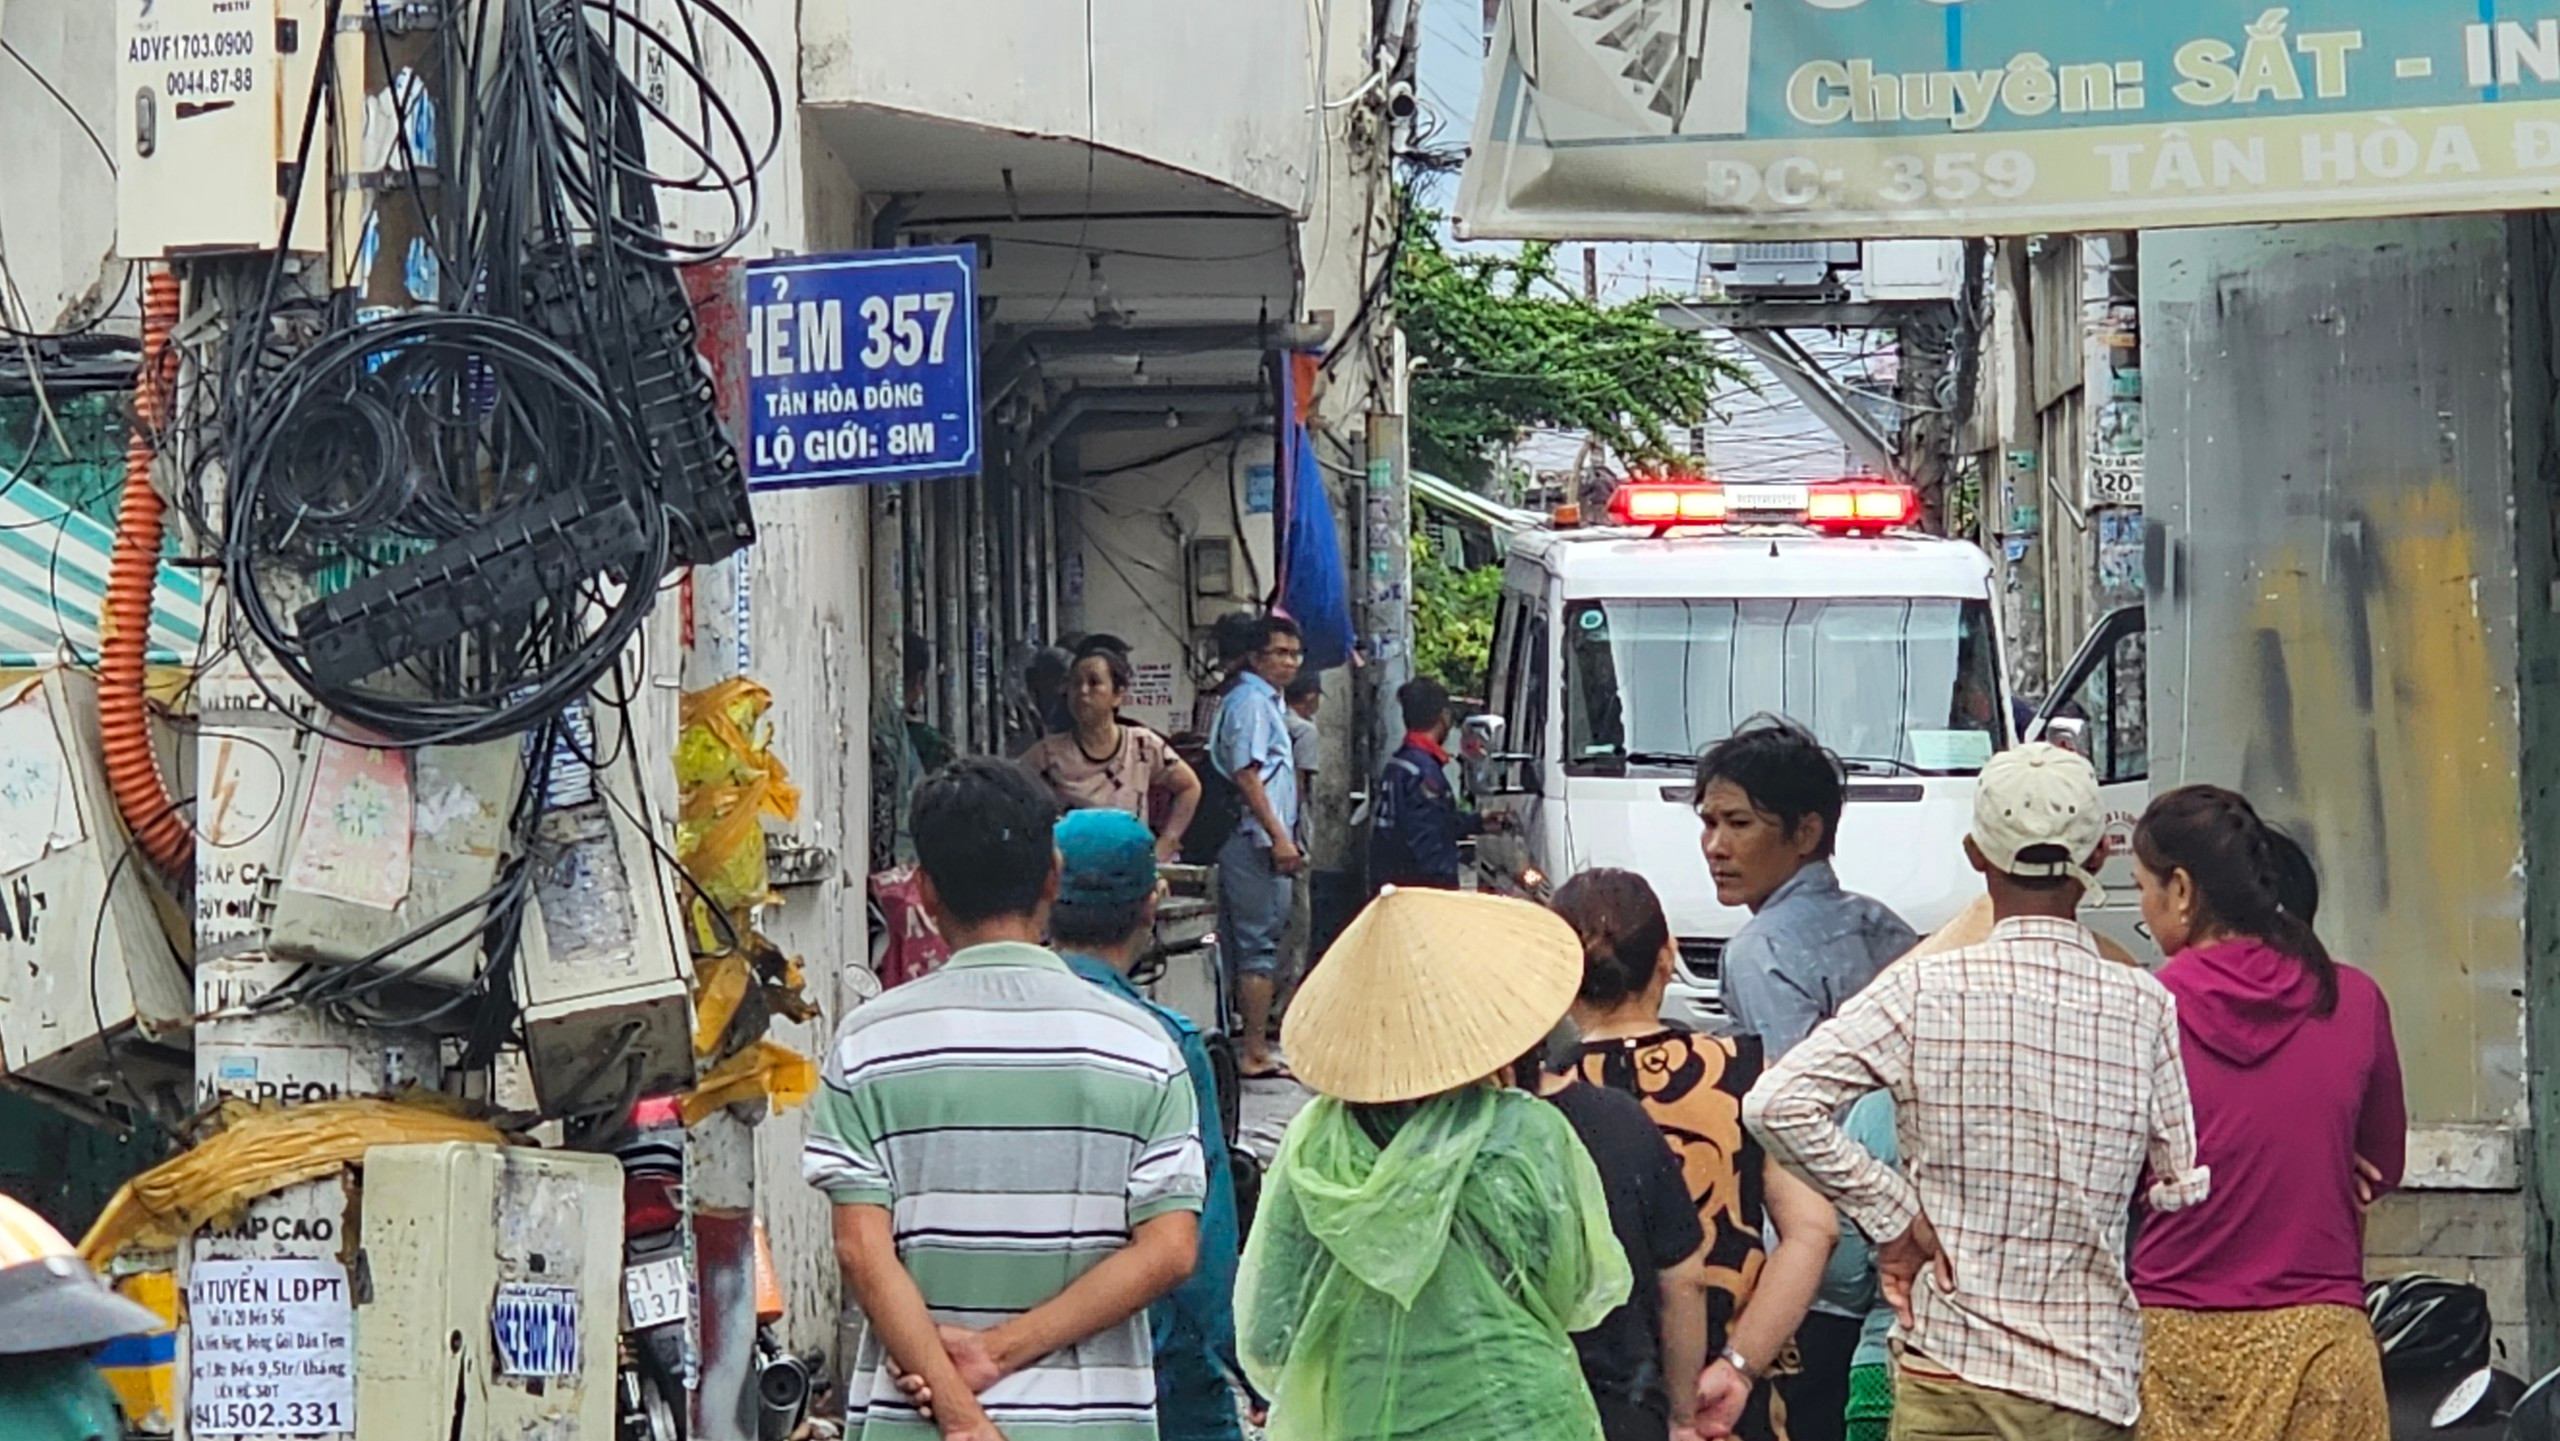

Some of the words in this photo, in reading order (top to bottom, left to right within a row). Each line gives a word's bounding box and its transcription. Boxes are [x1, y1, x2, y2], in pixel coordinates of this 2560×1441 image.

[128, 30, 253, 63] ADVF1703.0900
[1786, 52, 2144, 132] Chuyên:
[2172, 8, 2361, 105] SẮT
[2466, 19, 2560, 86] IN
[1703, 156, 1844, 206] ĐC:
[1878, 149, 2036, 203] 359
[2094, 126, 2267, 193] TÂN
[2302, 116, 2480, 183] HÒA
[859, 291, 955, 369] 357
[765, 385, 807, 418] TÂN
[813, 382, 860, 415] HÒA
[864, 379, 924, 410] ĐÔNG
[756, 425, 796, 471] LỘ
[804, 420, 878, 463] GIỚI:
[887, 422, 935, 456] 8M
[272, 1216, 333, 1241] CAO
[207, 1264, 268, 1304] TUYỂN
[278, 1278, 341, 1302] LĐPT
